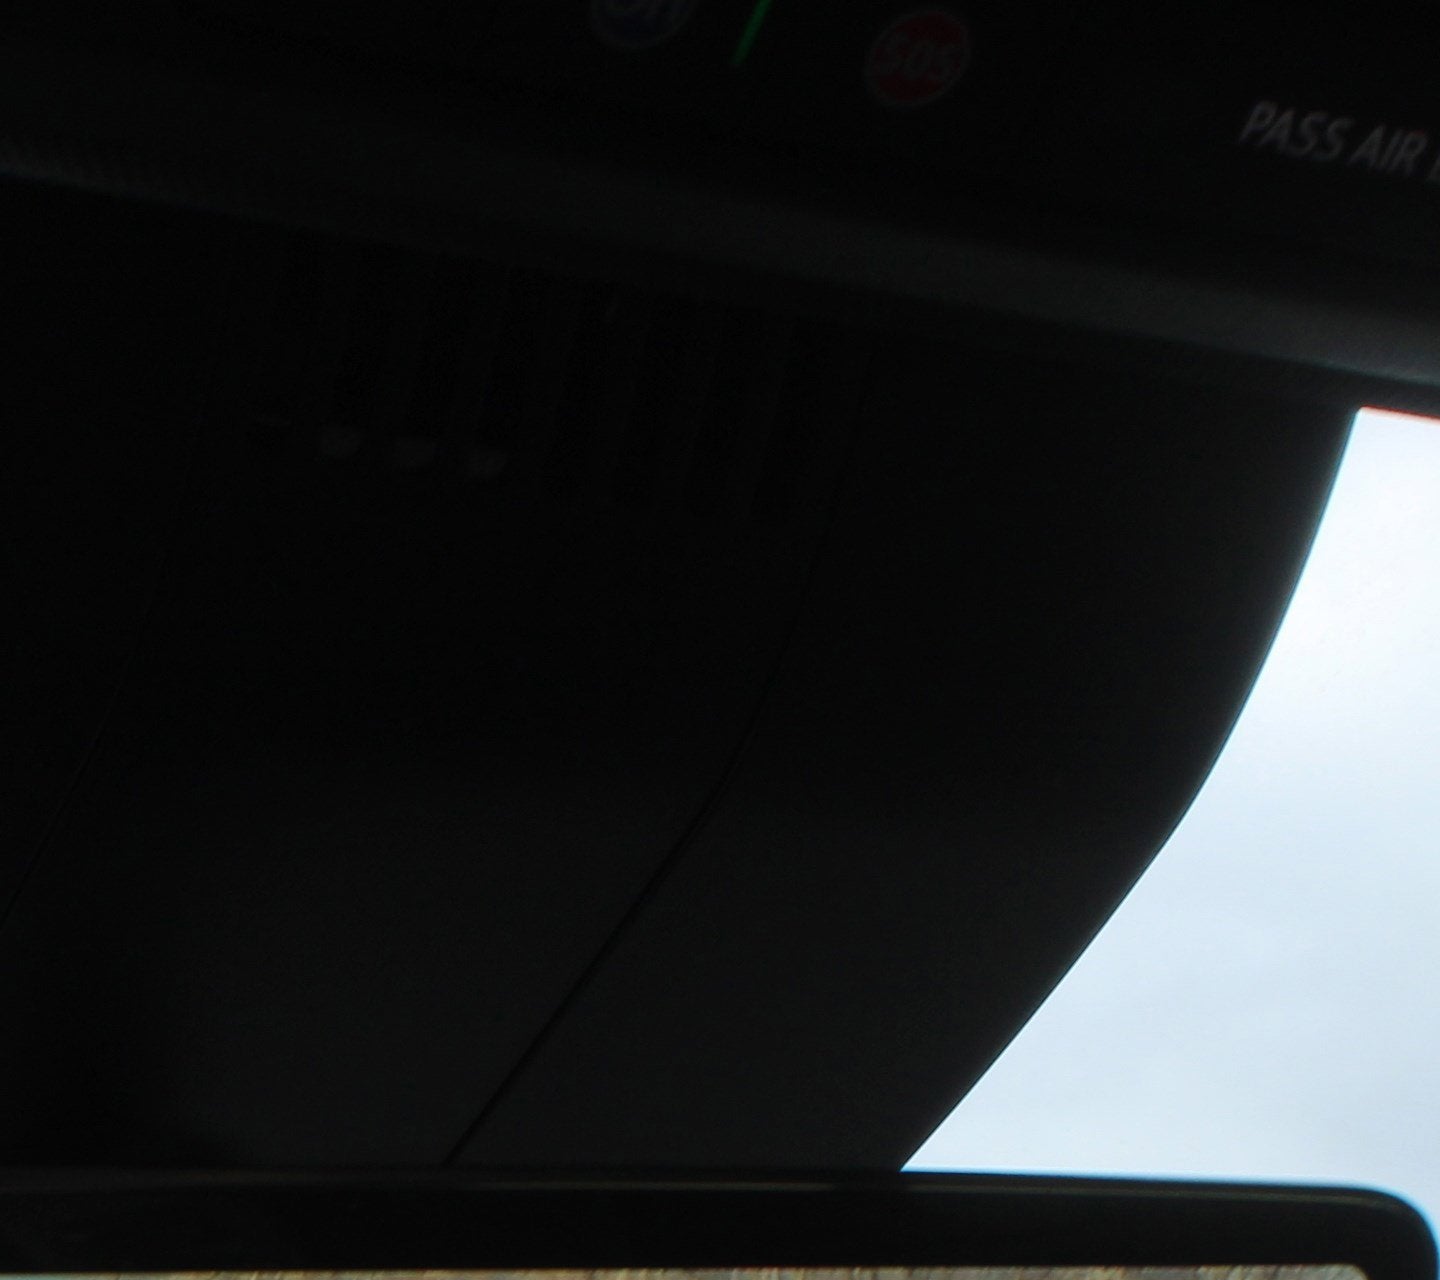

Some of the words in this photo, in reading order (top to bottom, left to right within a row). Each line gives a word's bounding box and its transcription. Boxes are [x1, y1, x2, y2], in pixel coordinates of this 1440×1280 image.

[873, 32, 958, 80] SOS
[1238, 98, 1354, 162] PASS
[1347, 123, 1430, 178] AIR
